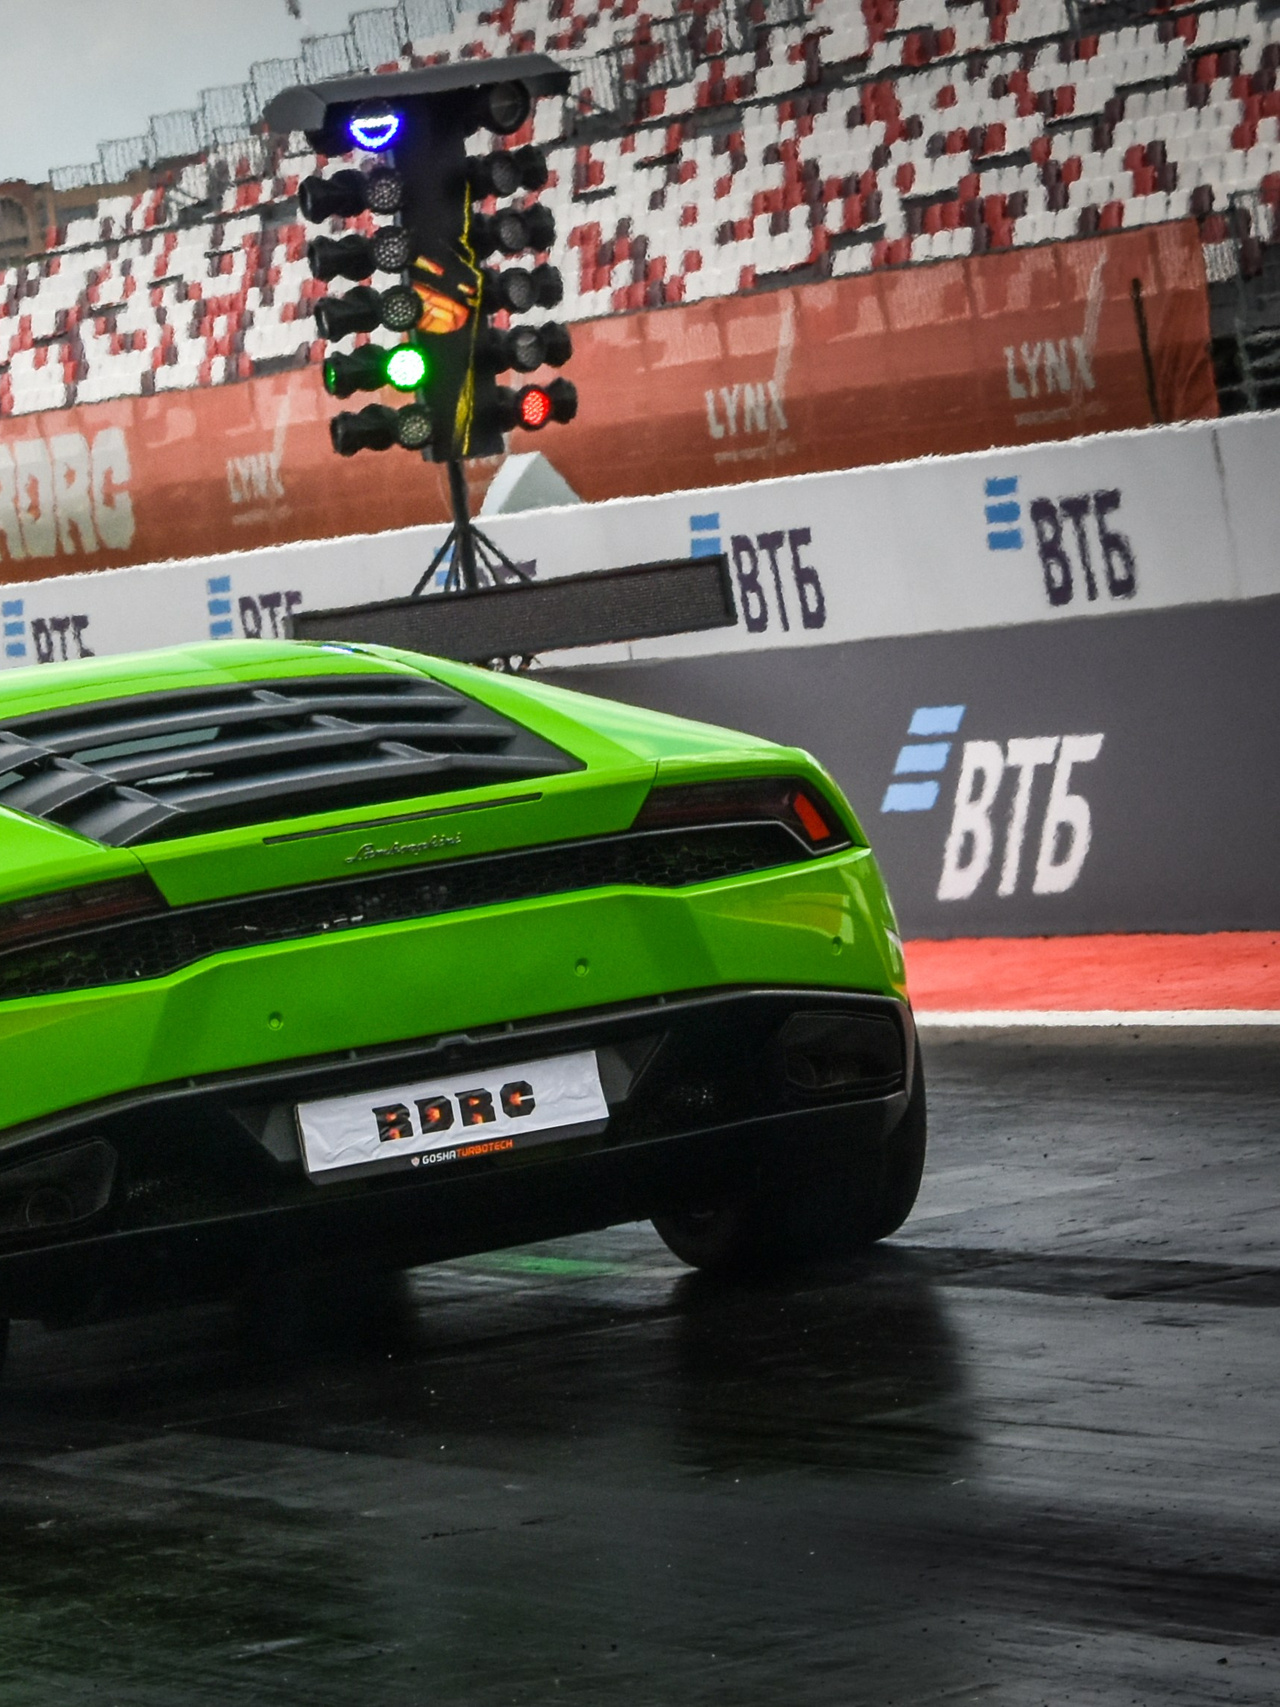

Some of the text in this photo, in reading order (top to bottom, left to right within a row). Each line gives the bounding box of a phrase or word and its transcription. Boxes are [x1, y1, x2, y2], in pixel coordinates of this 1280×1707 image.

[730, 527, 826, 633] ВТБ
[1029, 488, 1137, 607] ВТБ
[937, 733, 1105, 901] ВТБ
